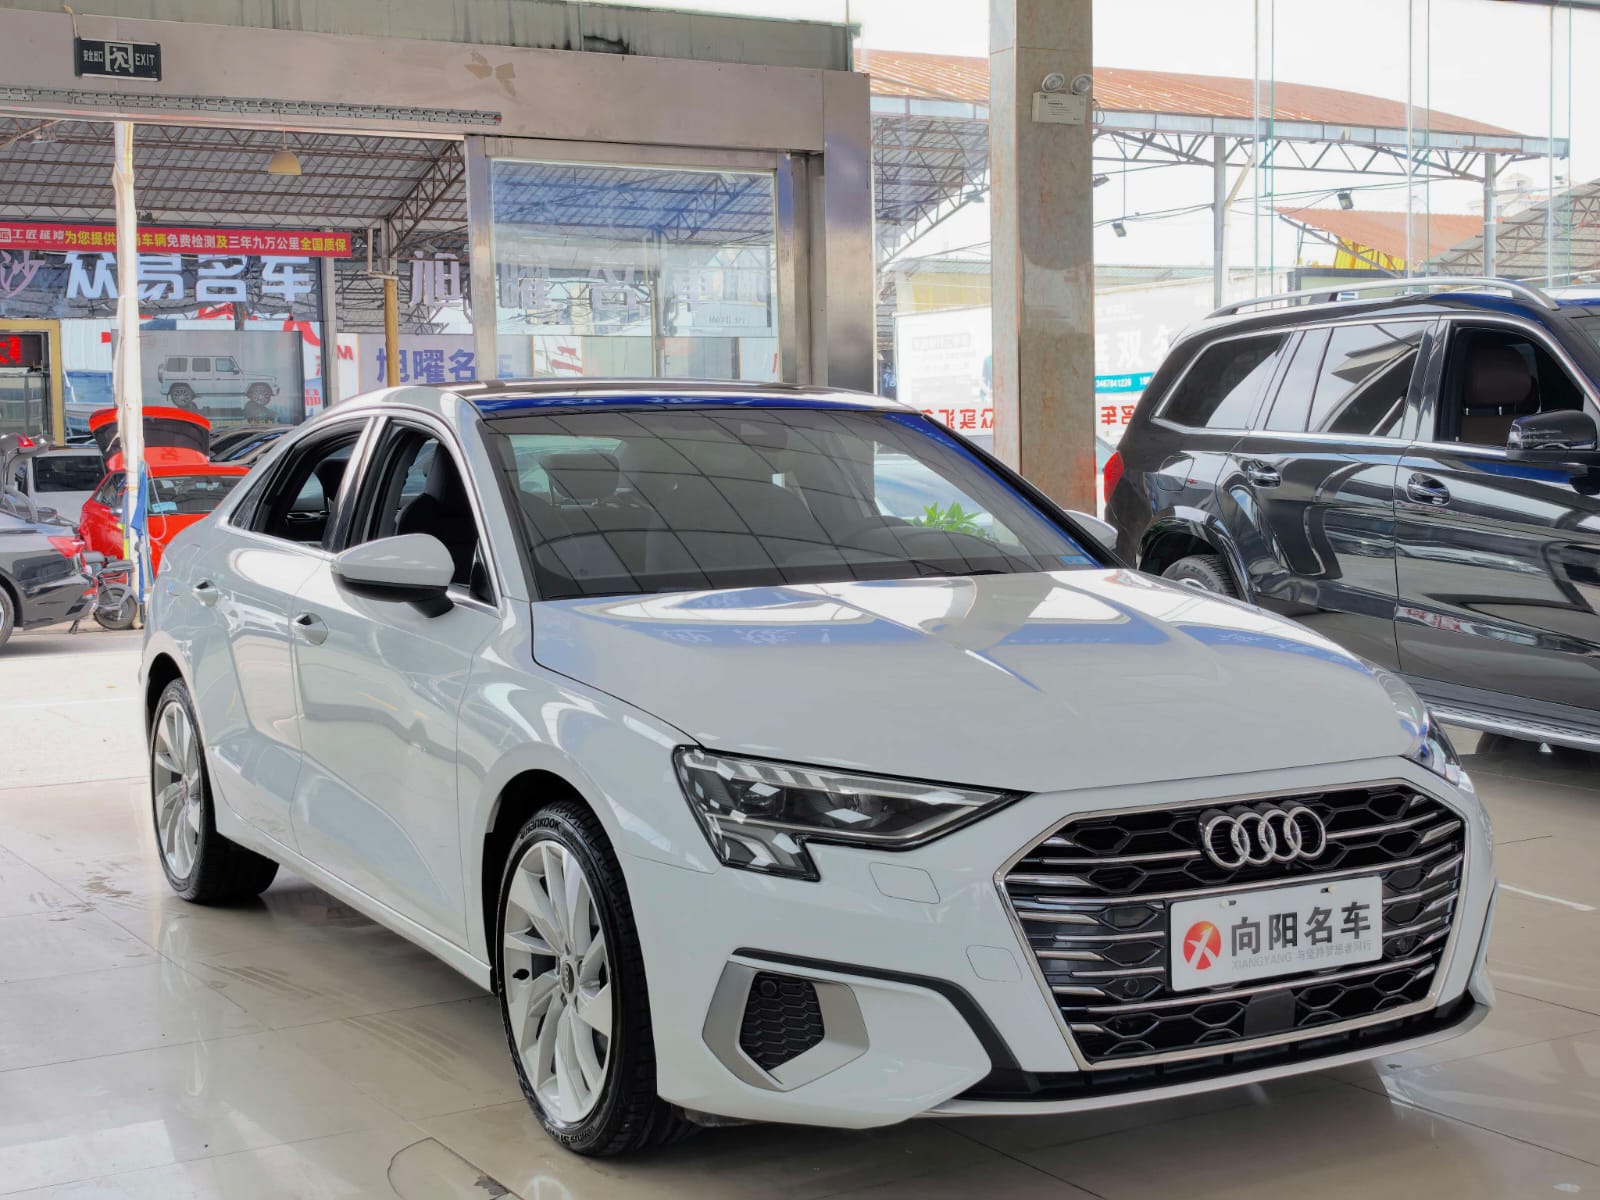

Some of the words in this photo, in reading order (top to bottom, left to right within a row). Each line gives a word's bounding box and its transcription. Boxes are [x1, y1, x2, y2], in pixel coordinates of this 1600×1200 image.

[135, 53, 155, 67] EXIT
[1231, 901, 1371, 957] 向阳名车
[1231, 952, 1293, 971] XIANGYANG
